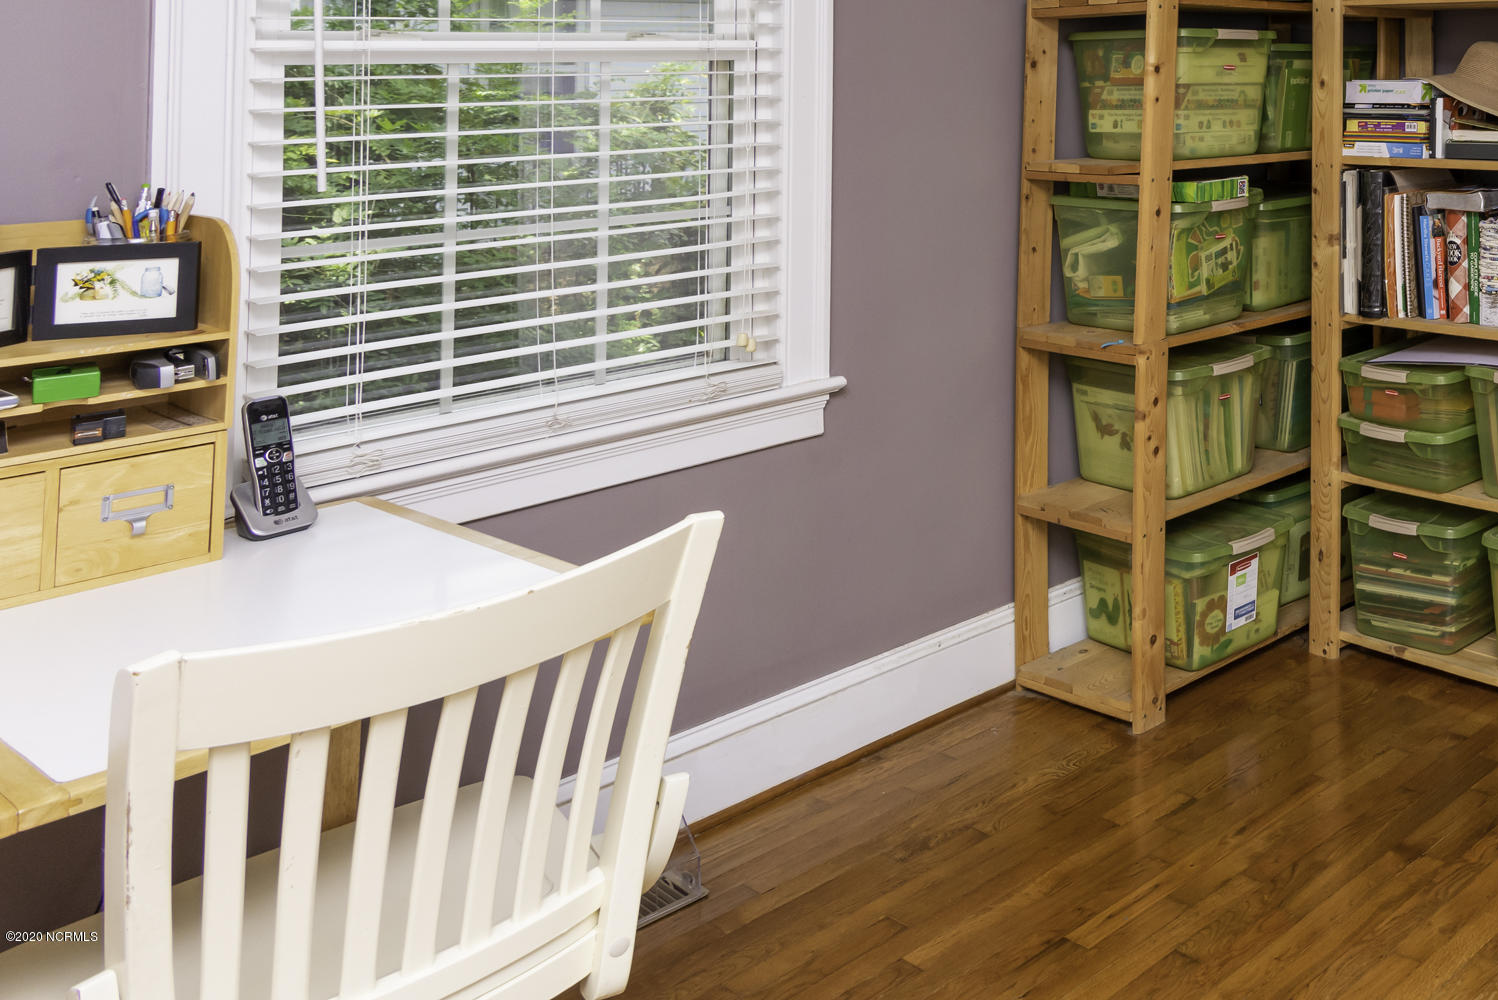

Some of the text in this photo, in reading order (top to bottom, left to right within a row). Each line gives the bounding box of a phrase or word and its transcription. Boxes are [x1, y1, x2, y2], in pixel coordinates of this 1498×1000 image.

[274, 465, 280, 473] 2
[286, 462, 293, 470] 3
[263, 472, 294, 486] 4 5 6
[264, 481, 295, 496] 7 8 9
[278, 494, 285, 503] 0
